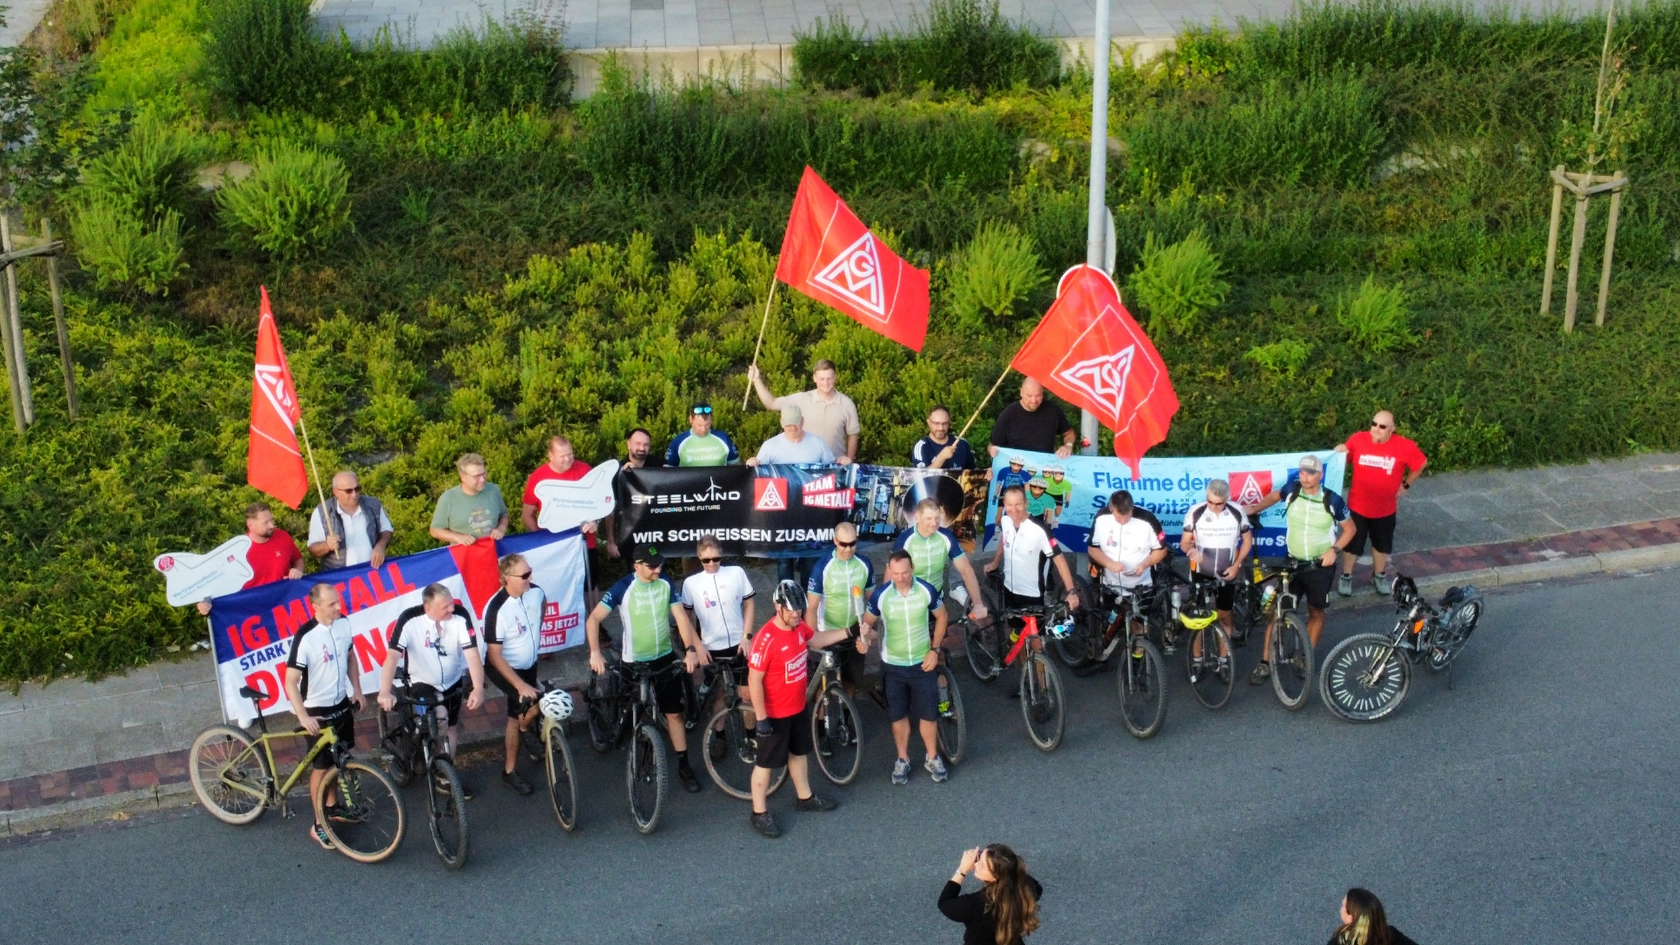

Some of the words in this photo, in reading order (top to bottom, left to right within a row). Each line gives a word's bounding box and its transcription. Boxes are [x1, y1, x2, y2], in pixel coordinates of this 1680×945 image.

[804, 476, 833, 493] TEAM
[1093, 471, 1174, 491] Flamme
[1177, 472, 1212, 491] der
[631, 486, 741, 505] STEELWIND
[804, 495, 815, 504] IG
[814, 490, 852, 508] METALL
[1091, 495, 1197, 515] Sdaritä
[633, 531, 664, 544] WIR
[667, 528, 771, 543] SCHWEISSEN
[775, 525, 860, 542] ZUSAM!
[226, 615, 271, 658] IG
[272, 562, 416, 640] MTALL
[540, 621, 553, 631] AS
[554, 616, 577, 631] JETZT
[540, 634, 564, 646] ÄHLT.
[239, 643, 287, 672] STARK
